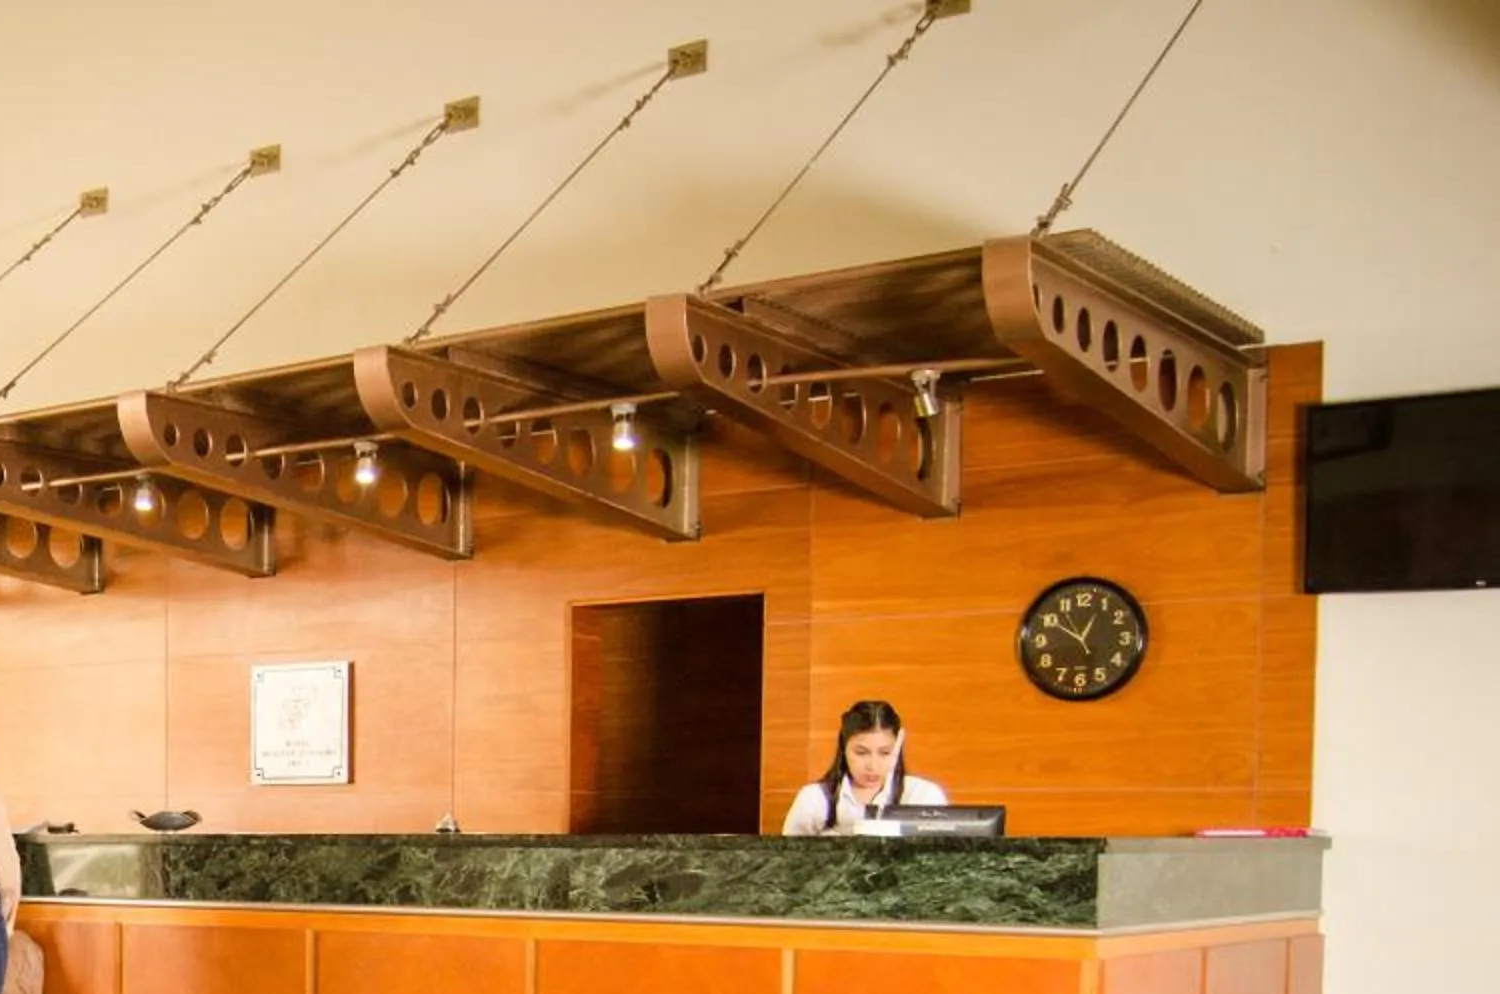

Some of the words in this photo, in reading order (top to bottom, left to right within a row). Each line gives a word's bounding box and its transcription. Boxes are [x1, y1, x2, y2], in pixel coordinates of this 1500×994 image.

[1060, 598, 1071, 612] 11
[1076, 593, 1092, 607] 12
[1101, 598, 1108, 611] 1
[1043, 613, 1058, 627] 10
[1113, 610, 1124, 625] 2
[1035, 634, 1047, 648] 9
[1118, 631, 1131, 645] 3
[1040, 654, 1052, 667] 8
[1110, 652, 1122, 667] 4
[1056, 668, 1068, 682] 7
[1074, 673, 1086, 687] 6
[1094, 668, 1107, 681] 5
